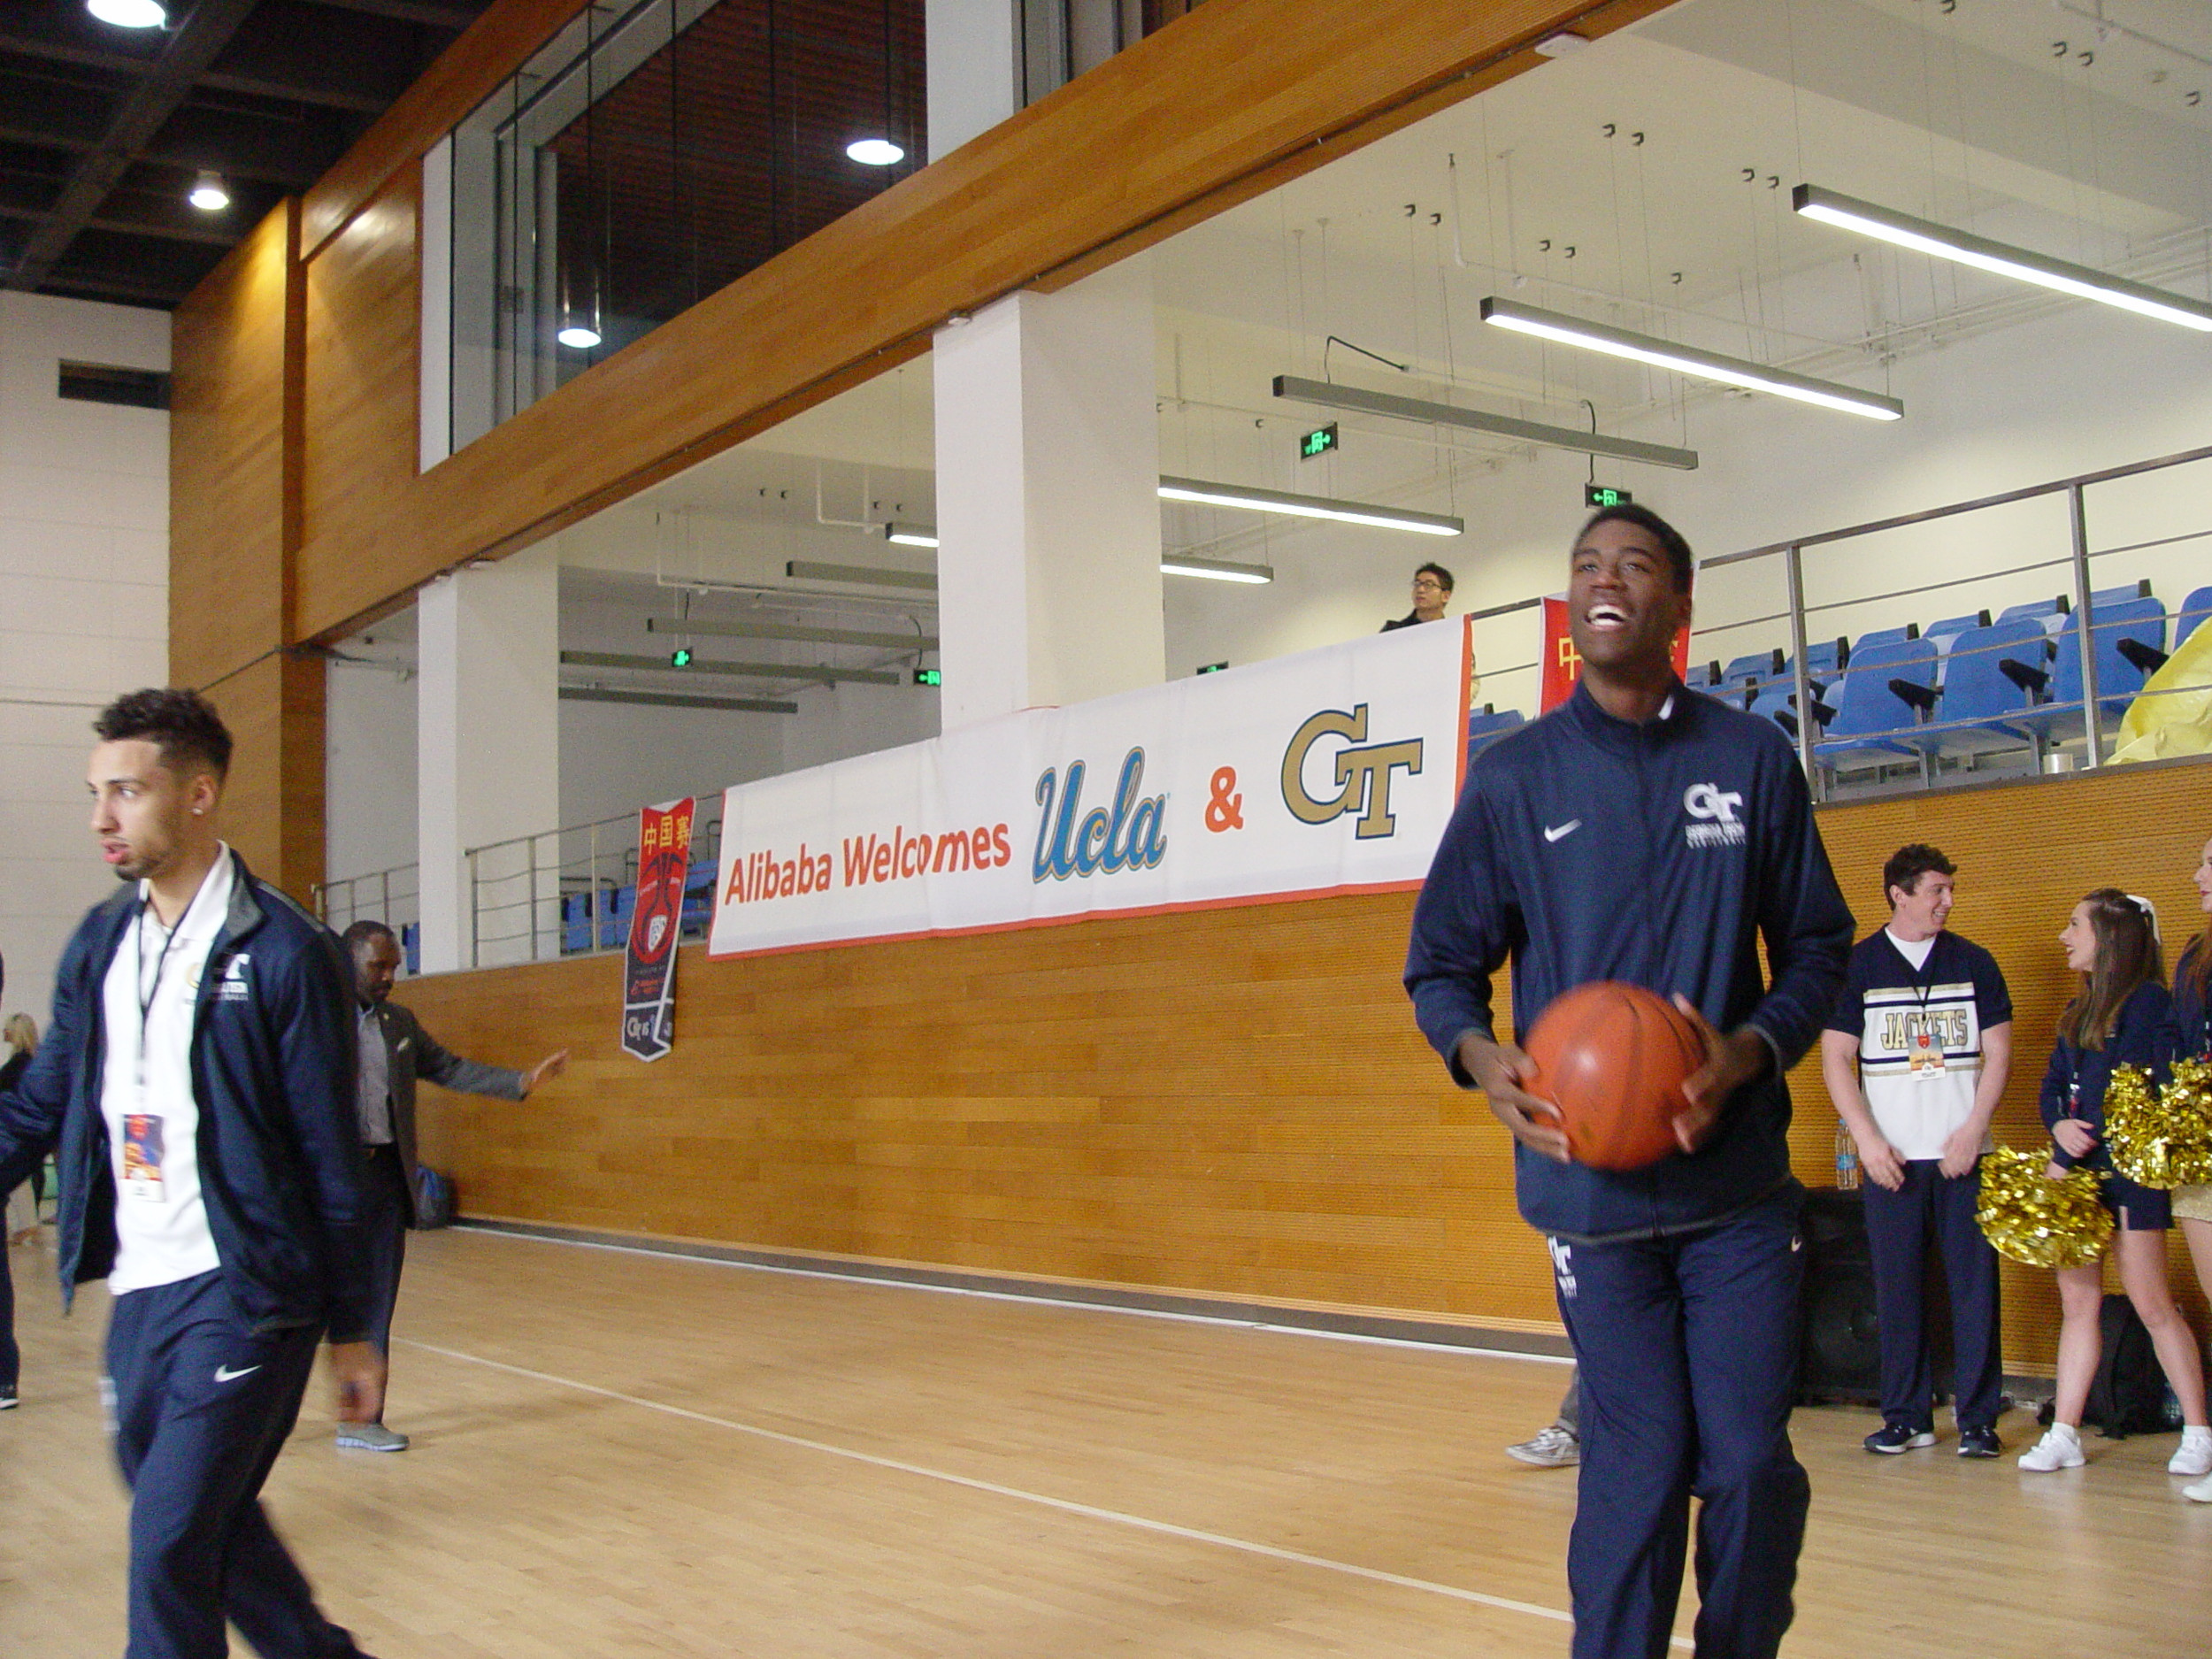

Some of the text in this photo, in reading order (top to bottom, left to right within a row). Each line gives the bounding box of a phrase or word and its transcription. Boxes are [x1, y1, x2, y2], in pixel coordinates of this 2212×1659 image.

[724, 845, 833, 904] Alibaba
[842, 821, 1011, 887] Welcomes
[1204, 765, 1244, 833] &
[1280, 702, 1423, 840] GT
[1880, 1009, 1968, 1050] JACKETS
